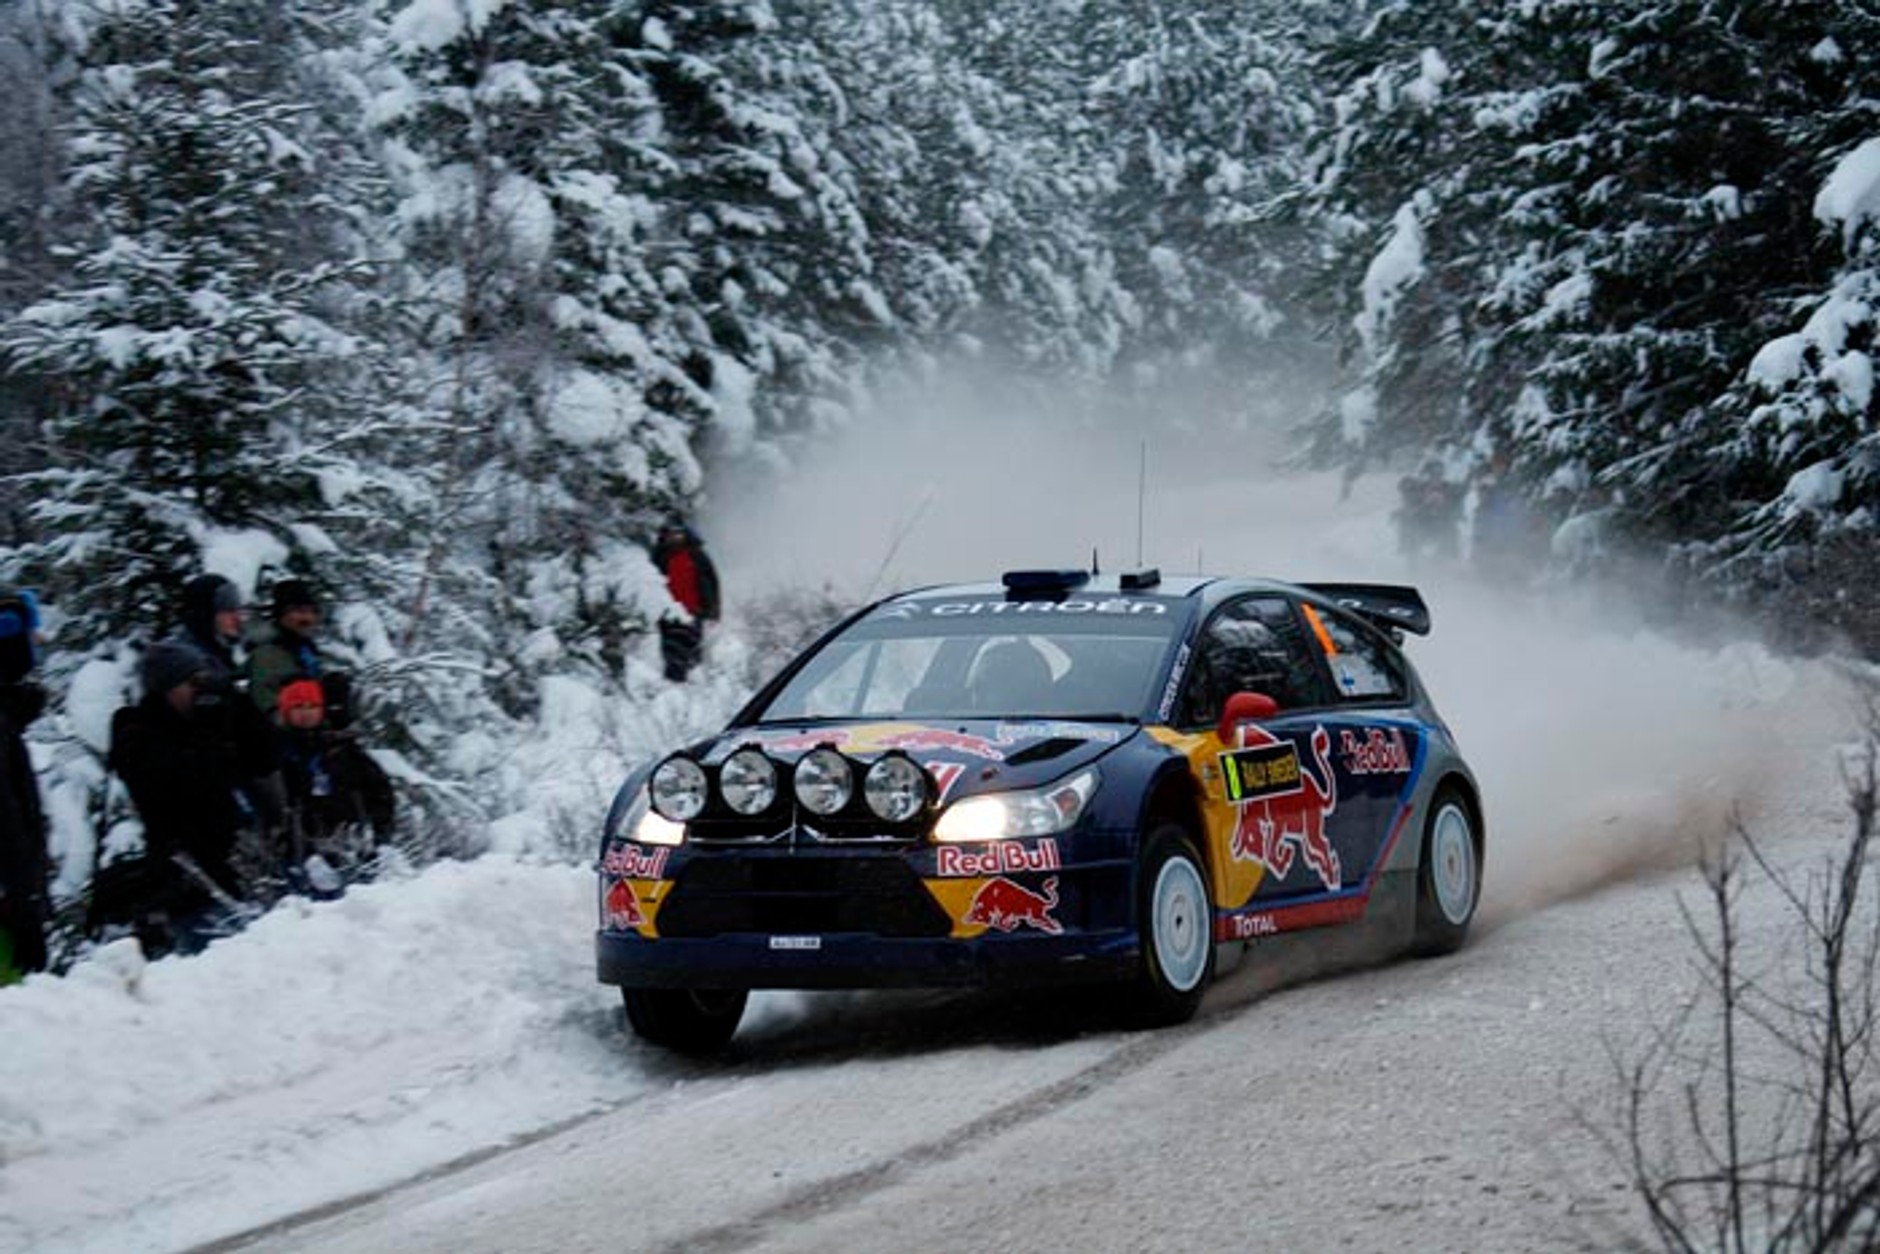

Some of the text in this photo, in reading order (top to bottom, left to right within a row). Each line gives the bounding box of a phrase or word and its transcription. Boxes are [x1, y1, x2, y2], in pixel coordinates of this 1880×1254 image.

[621, 843, 670, 879] Bull
[937, 838, 1060, 876] Red Bull
